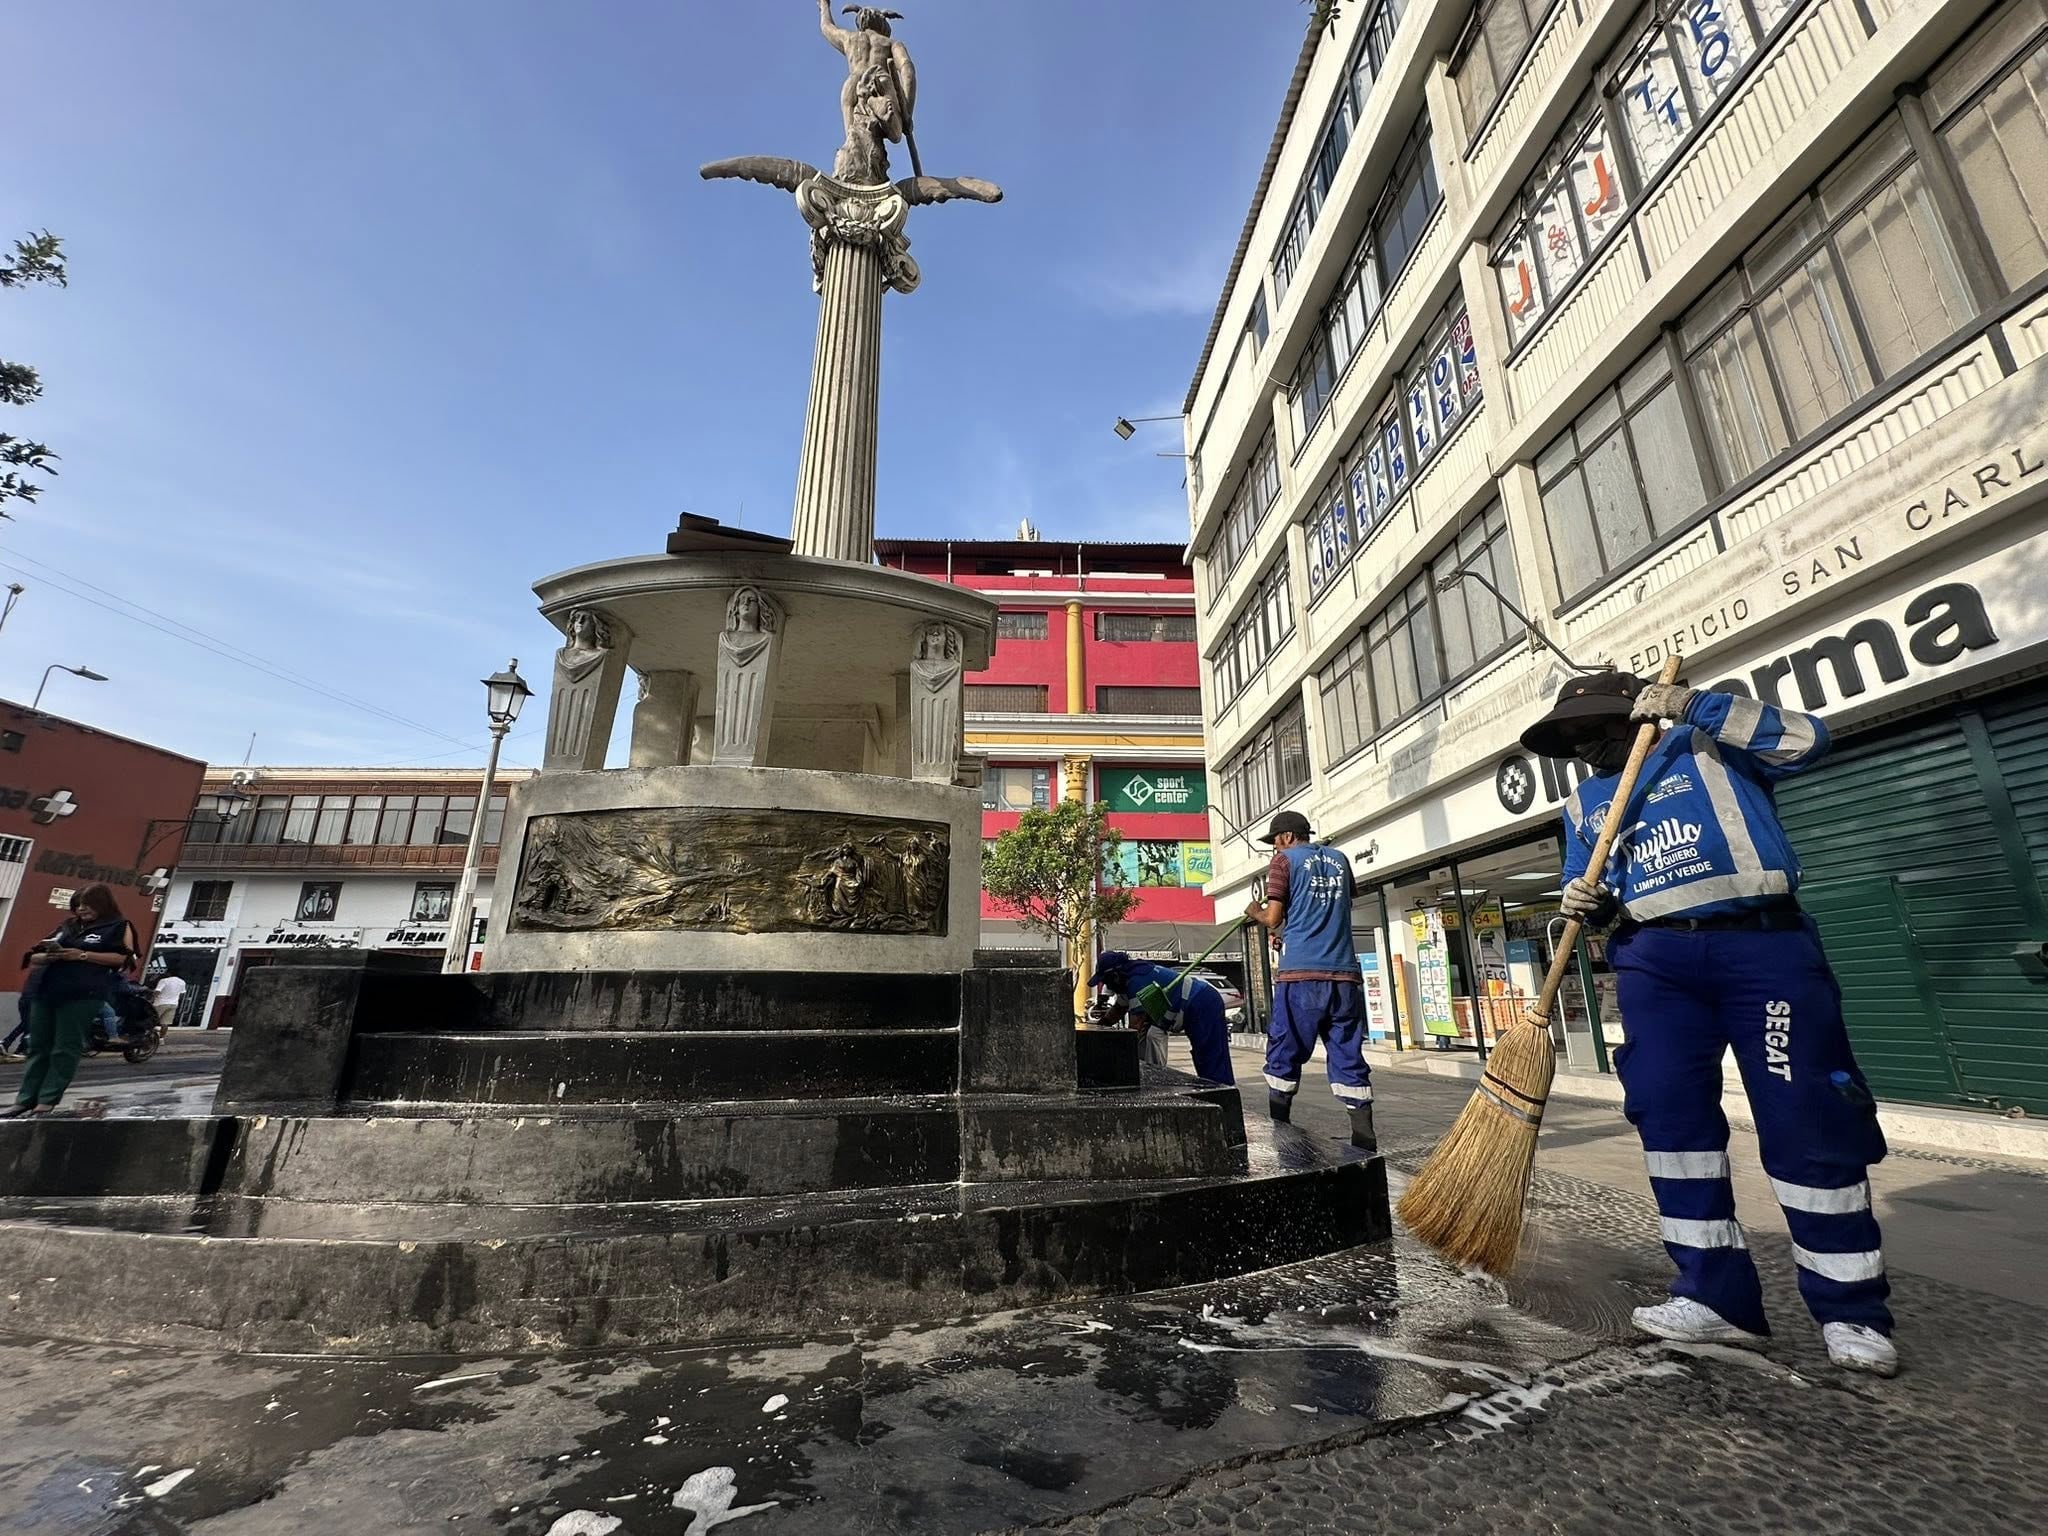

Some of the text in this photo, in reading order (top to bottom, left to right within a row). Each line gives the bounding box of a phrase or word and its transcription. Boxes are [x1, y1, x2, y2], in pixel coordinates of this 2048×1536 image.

[1630, 448, 2044, 674] EDIFICIO SAN CARL
[1156, 776, 1185, 789] sport
[1155, 791, 1189, 804] center
[1643, 846, 1698, 874] TE QUIERO
[1633, 861, 1713, 893] LIMPIO Y VERDE
[182, 936, 226, 945] SPORT
[385, 931, 447, 943] PIRANI
[1765, 1000, 1792, 1082] SEGAT
